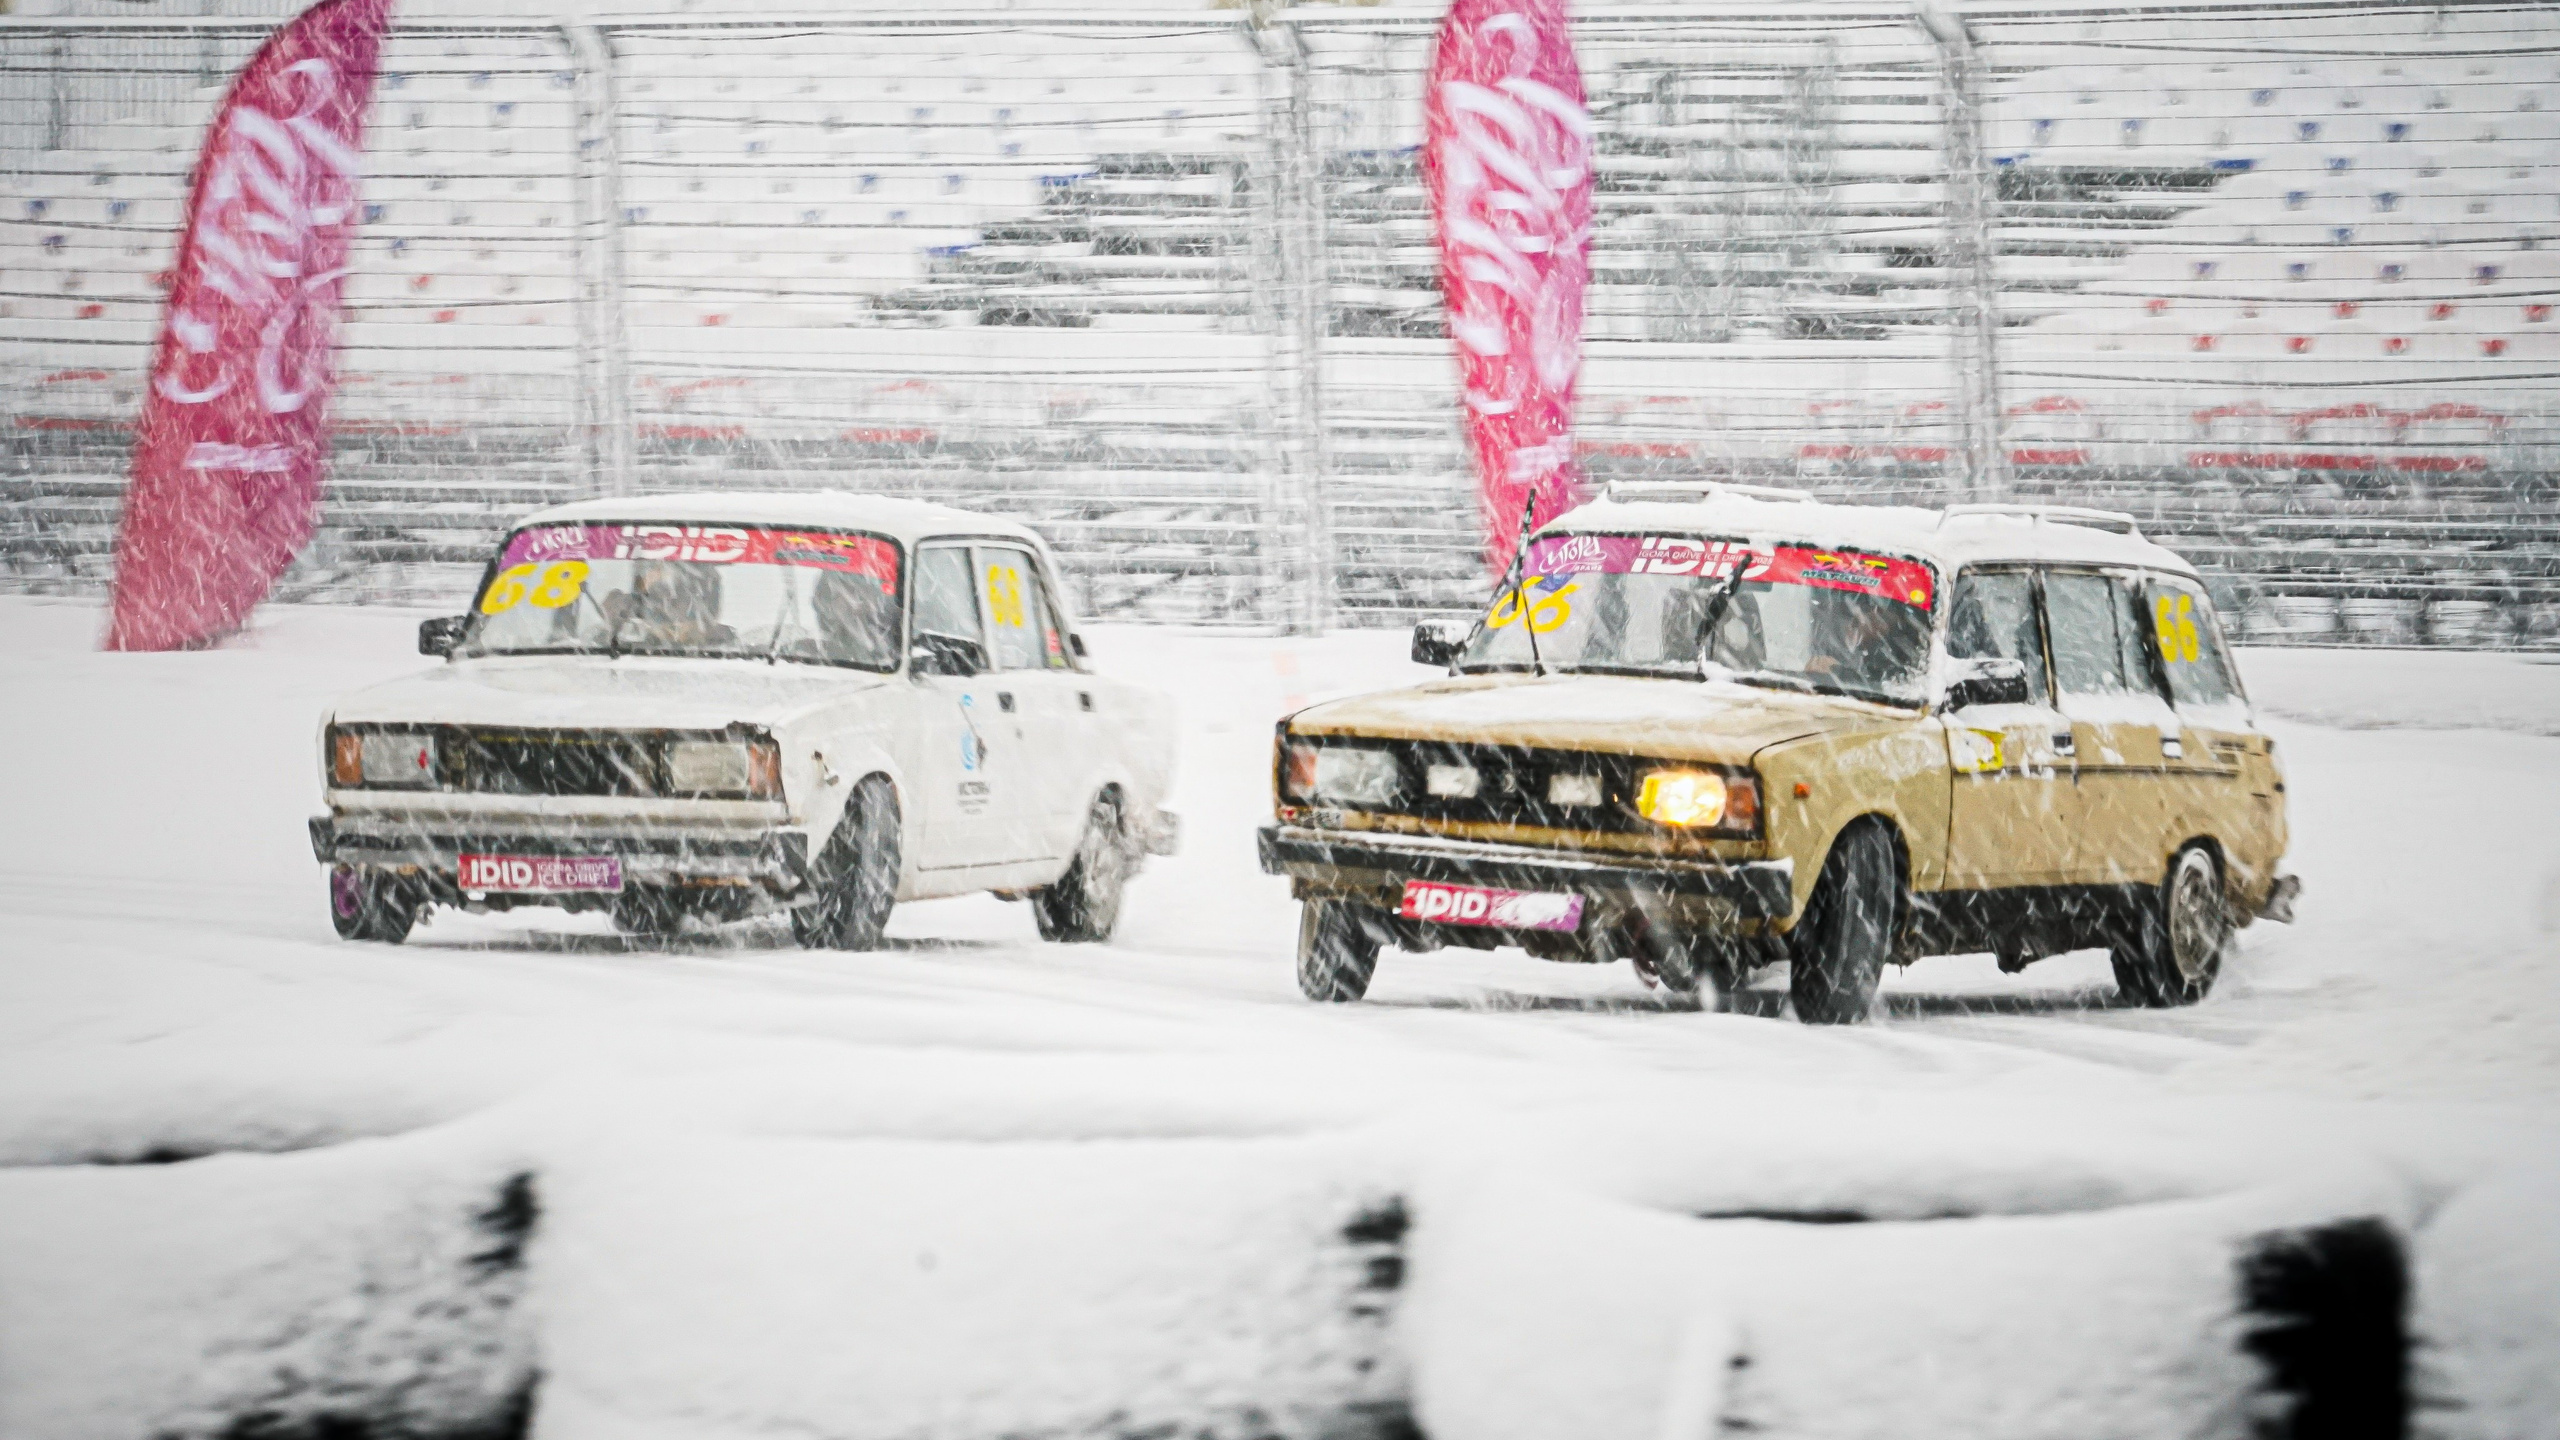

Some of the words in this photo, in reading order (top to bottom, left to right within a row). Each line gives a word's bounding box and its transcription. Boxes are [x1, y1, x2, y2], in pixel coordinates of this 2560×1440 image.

[614, 526, 750, 560] IDID
[1630, 537, 1776, 579] IDID
[1704, 553, 1719, 563] ICE
[481, 561, 590, 616] 68
[1486, 575, 1582, 634] 66
[2156, 593, 2198, 663] 66
[470, 858, 533, 886] IDID
[1413, 886, 1488, 919] IDID
